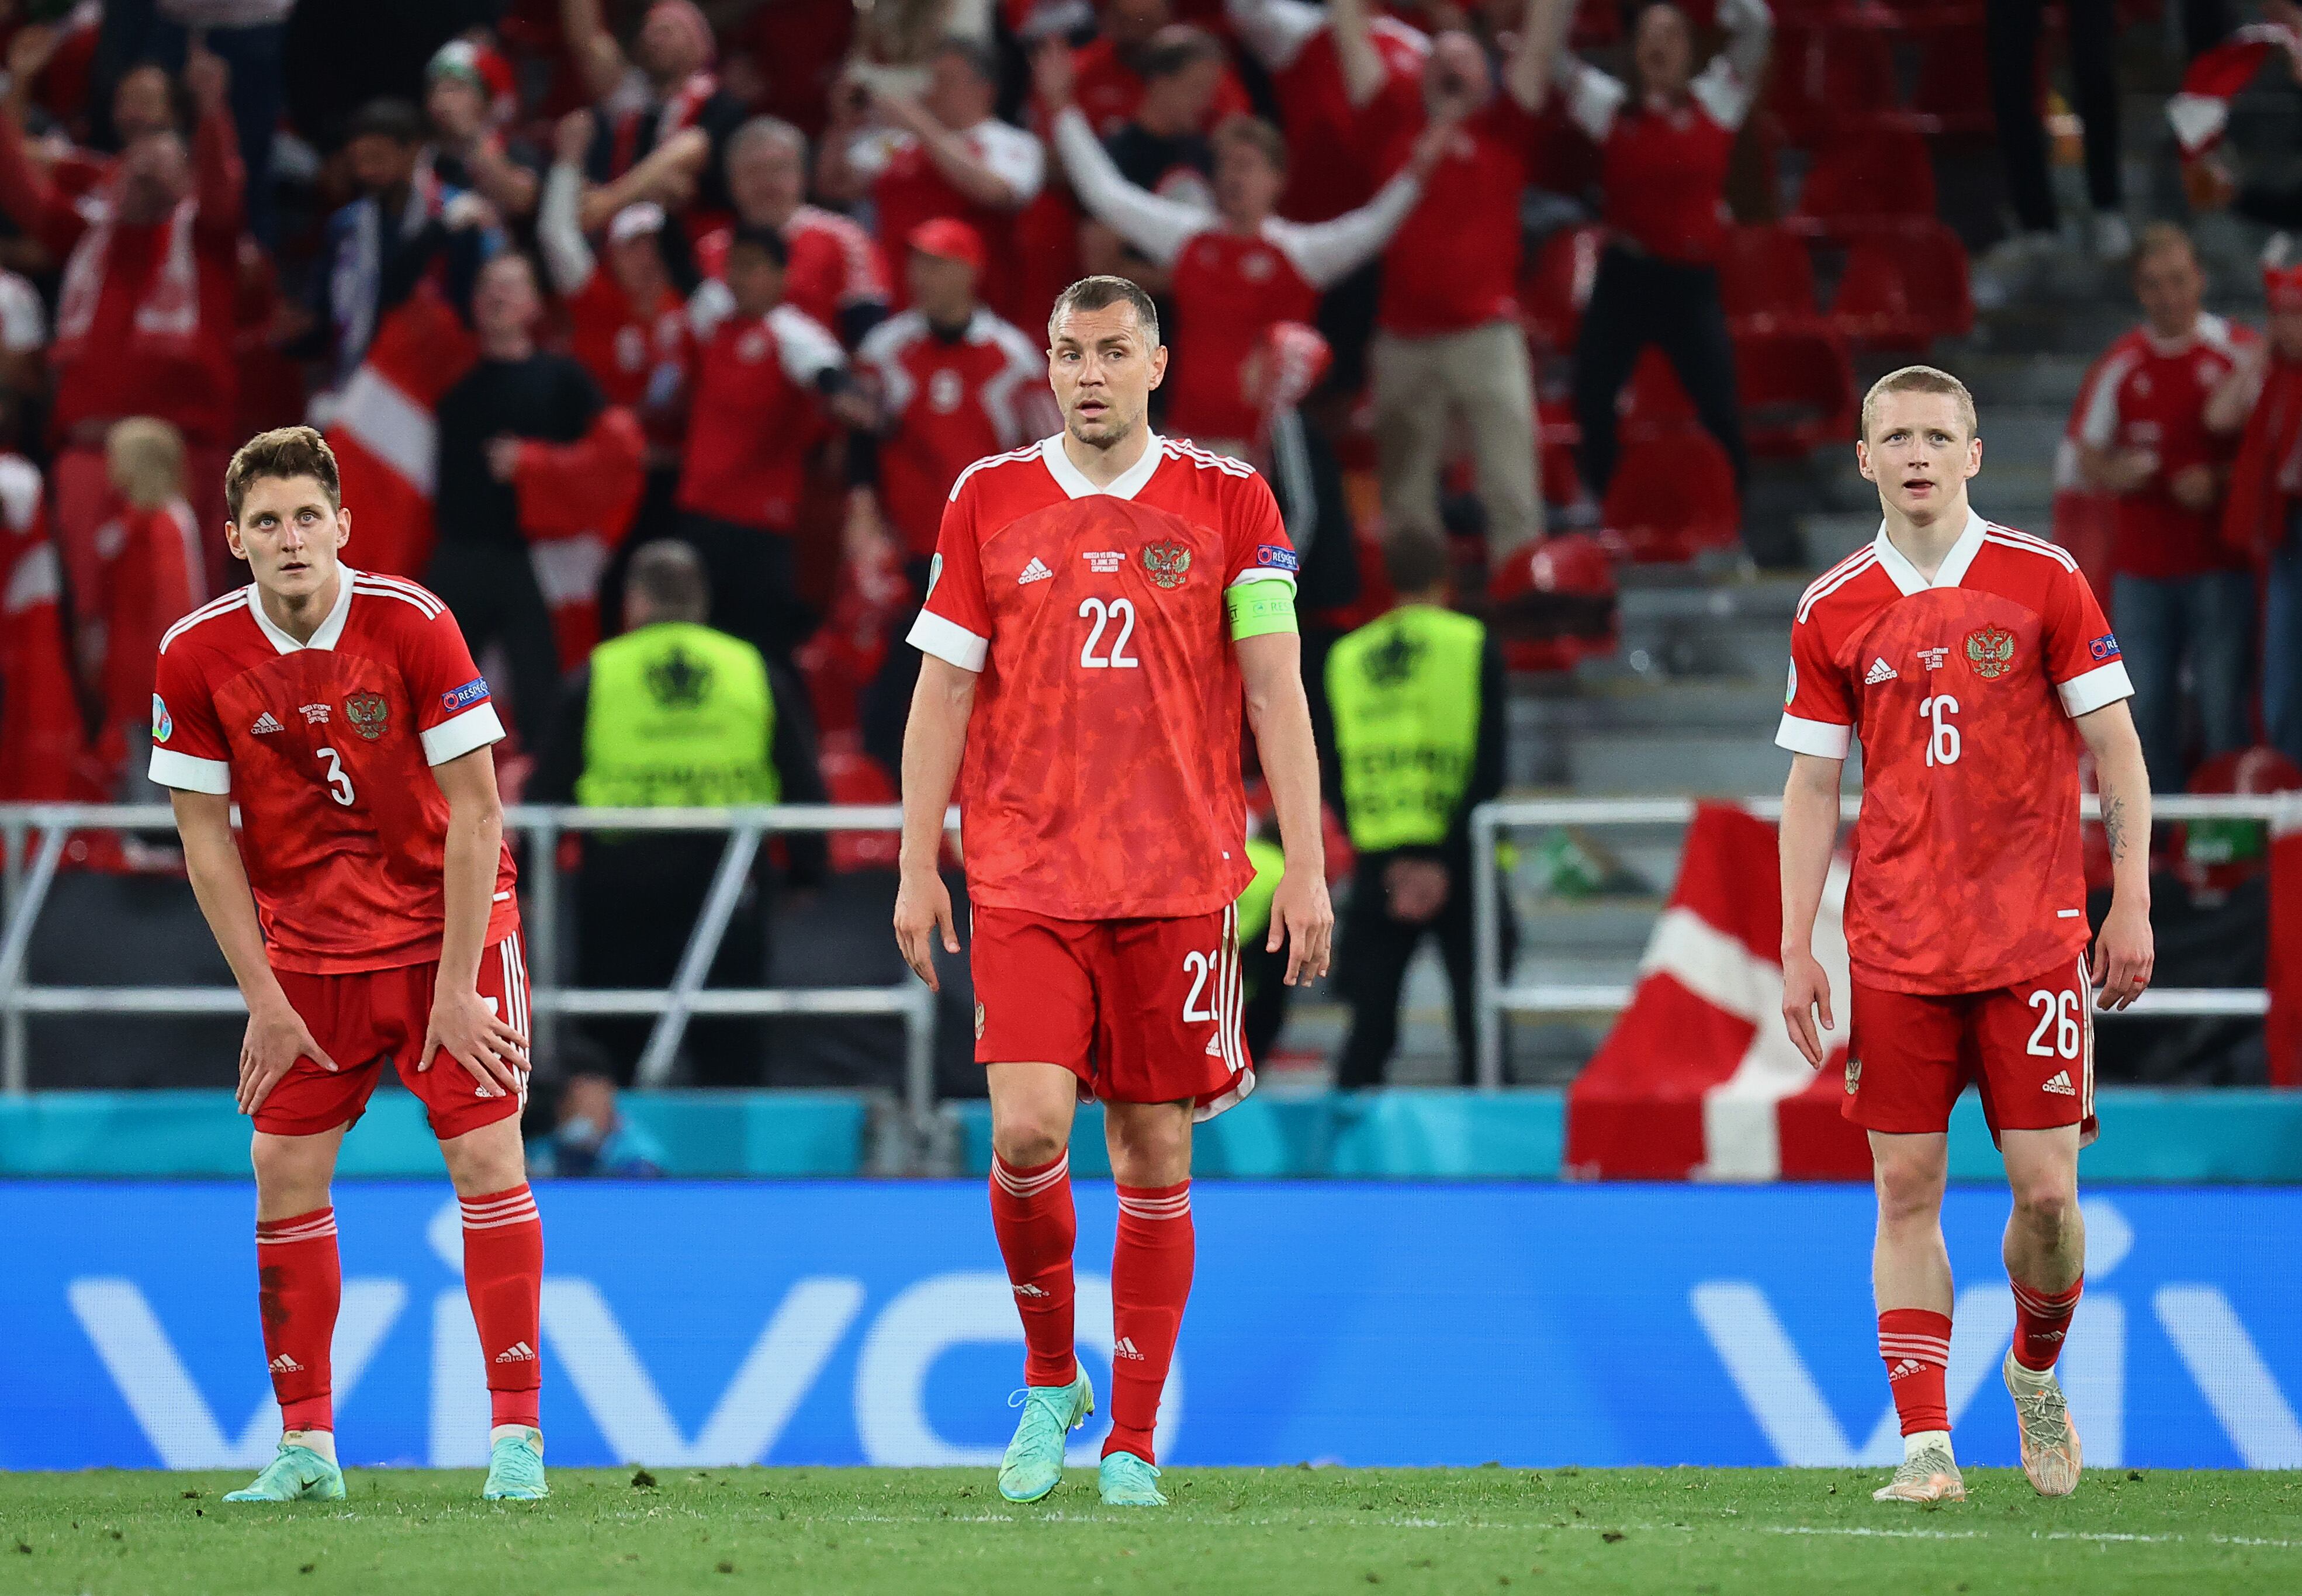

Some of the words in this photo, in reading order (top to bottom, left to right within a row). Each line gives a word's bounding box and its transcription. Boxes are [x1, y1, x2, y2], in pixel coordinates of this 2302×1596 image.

[1018, 569, 1053, 584] adidas
[1079, 597, 1138, 668] 22
[1865, 670, 1898, 684] adidas
[458, 680, 489, 702] RESPECT
[251, 725, 285, 734] adidas
[316, 747, 355, 806] 3
[2027, 989, 2079, 1060] 26
[2043, 1083, 2076, 1096] adidas
[68, 1196, 1183, 1469] vivo
[1115, 1349, 1145, 1361] didas
